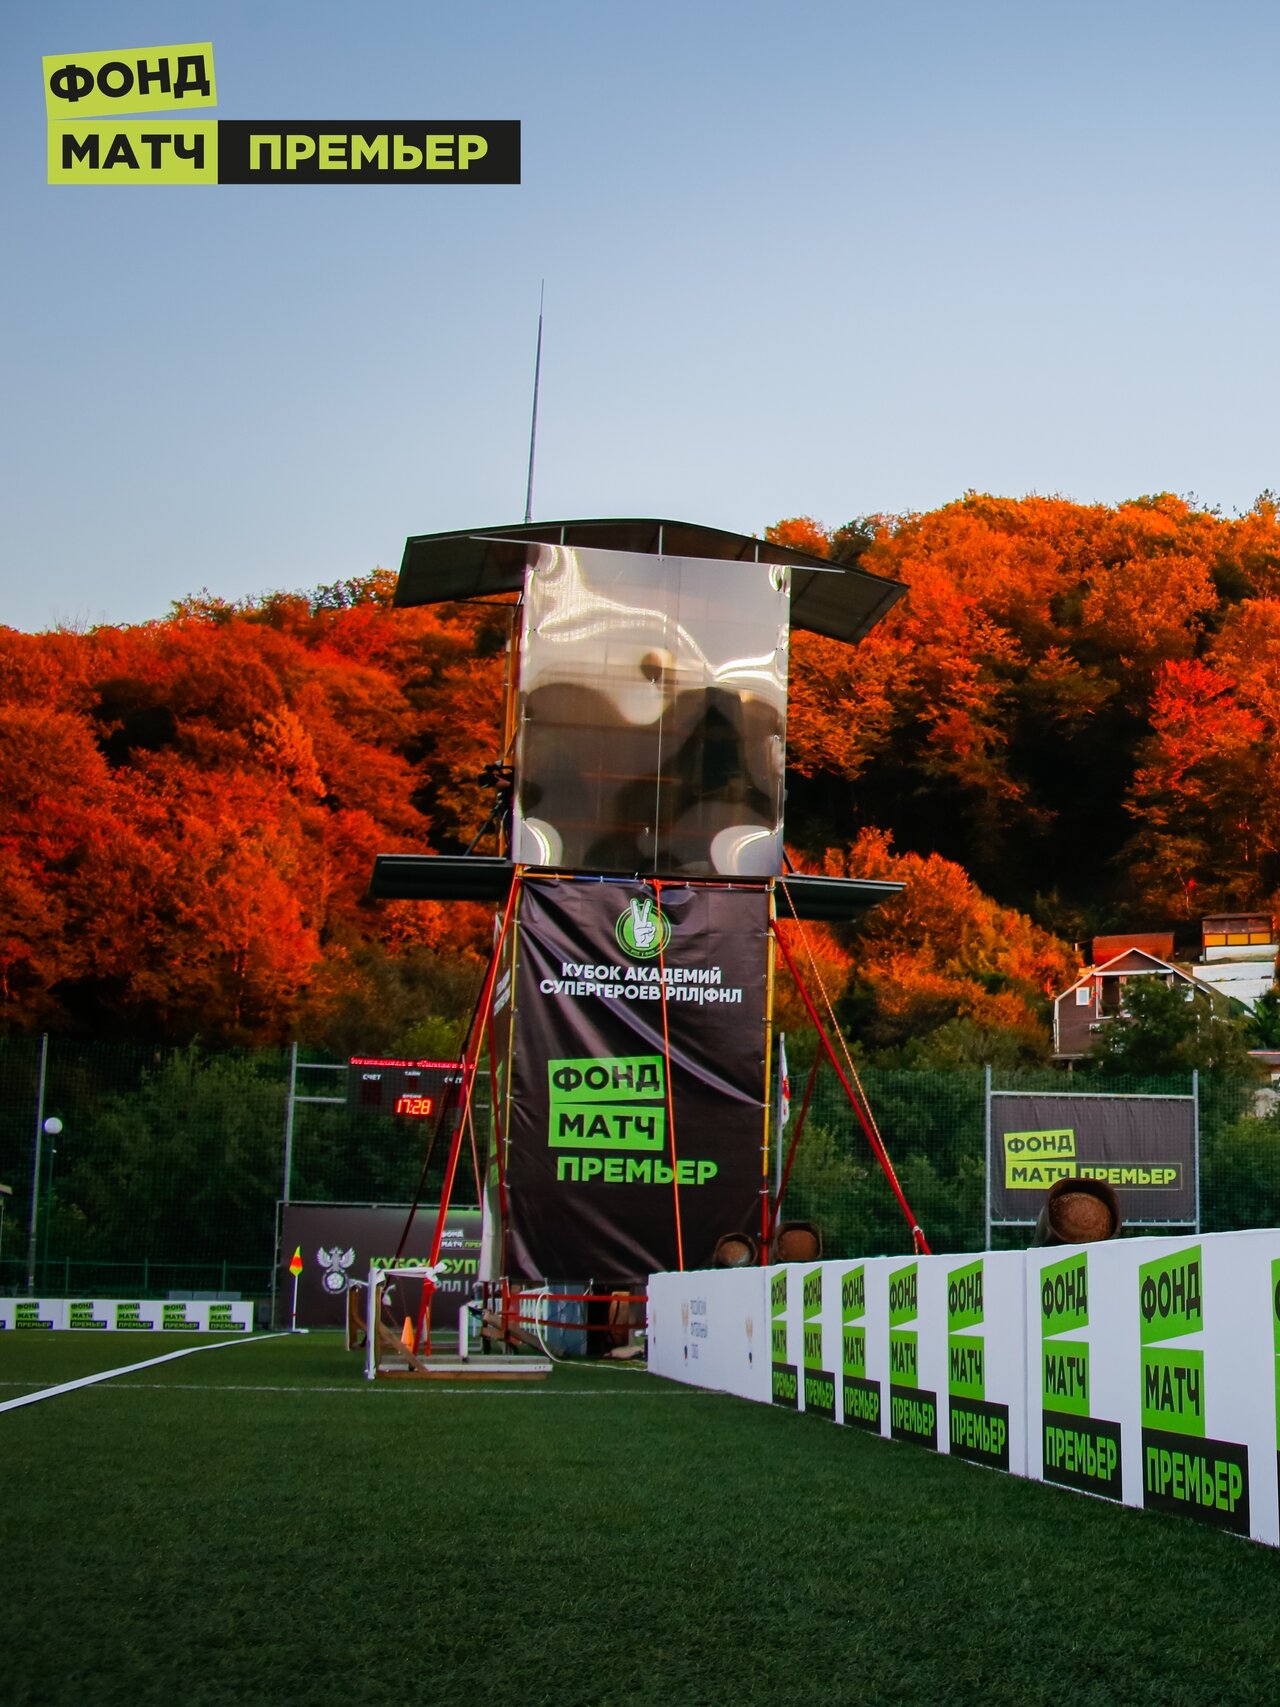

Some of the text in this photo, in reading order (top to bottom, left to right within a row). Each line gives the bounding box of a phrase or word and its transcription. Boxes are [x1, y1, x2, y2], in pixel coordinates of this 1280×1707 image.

[562, 962, 721, 984] КУБОК АКАДЕМИЙ
[540, 980, 660, 1000] СУПЕРГЕРОЕВ
[553, 1064, 660, 1092] ФОНД
[397, 1099, 431, 1115] 17:28
[559, 1113, 655, 1140] МАТЧ
[1007, 1135, 1072, 1154] ФОНД
[557, 1156, 718, 1185] ПРЕМЬЕР
[771, 1275, 787, 1305] ФОНД
[804, 1275, 822, 1307] ФОНД
[842, 1275, 865, 1310] ФОНД
[890, 1273, 917, 1313] ФОНД
[949, 1271, 983, 1317] ФОНД
[1042, 1265, 1088, 1319] ФОНД
[1141, 1261, 1201, 1323] ФОНД
[772, 1328, 787, 1350] МАТЧ
[805, 1331, 822, 1359] МАТЧ
[844, 1336, 865, 1366] МАТЧ
[892, 1342, 917, 1375] МАТЧ
[950, 1348, 982, 1385] МАТЧ
[773, 1371, 797, 1399] ПРЕМЬЕР
[806, 1377, 834, 1410] ПРЕМЬЕР
[1045, 1355, 1086, 1399] МАТЧ
[1145, 1364, 1200, 1417] МАТЧ
[845, 1387, 879, 1422] ПРЕМЬЕР
[892, 1397, 934, 1437] ПРЕМЬЕР
[951, 1409, 1005, 1455] ПРЕМЬЕР
[1046, 1427, 1117, 1481] ПРЕМЬЕР
[1146, 1446, 1242, 1512] ПРЕМЬЕР
